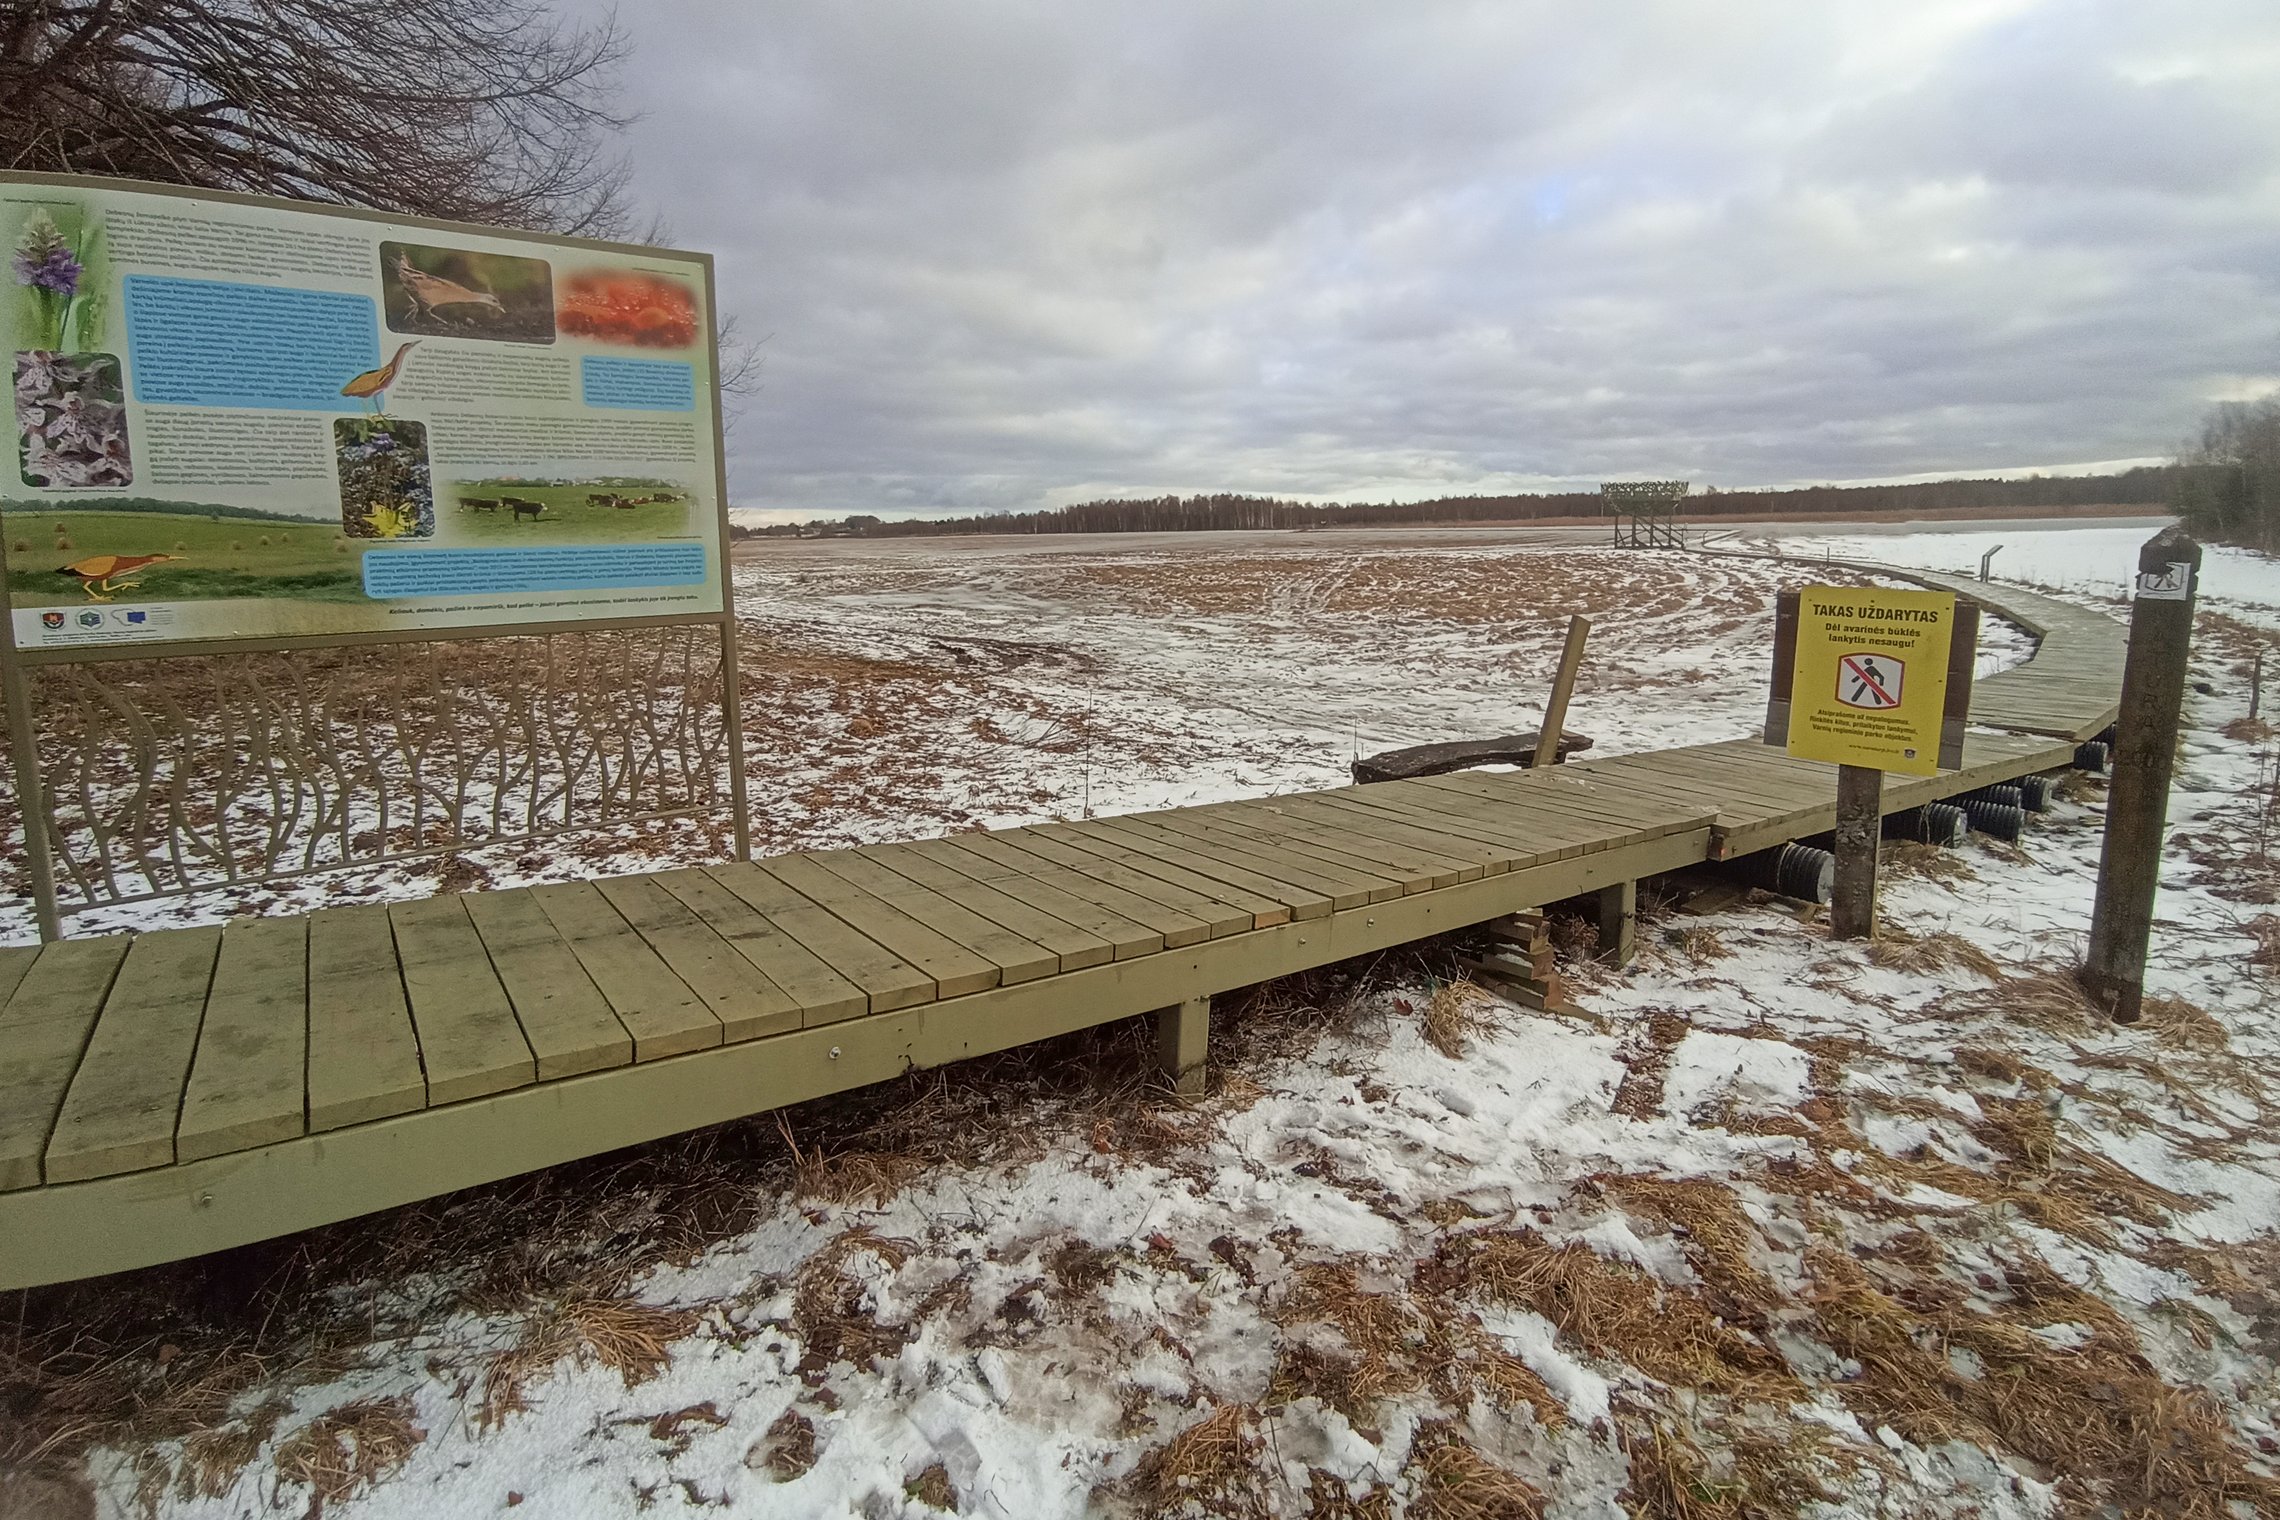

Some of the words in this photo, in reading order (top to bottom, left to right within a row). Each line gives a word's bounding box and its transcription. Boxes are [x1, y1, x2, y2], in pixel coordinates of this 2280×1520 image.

[1813, 604, 1854, 617] TAKAS
[1858, 605, 1938, 623] UŽDARYTAS
[1825, 622, 1841, 631] Dėl
[1843, 625, 1885, 635] avarinės
[1887, 626, 1921, 637] būklės
[1828, 633, 1866, 645] lankytis
[1868, 638, 1915, 649] nesaugu!
